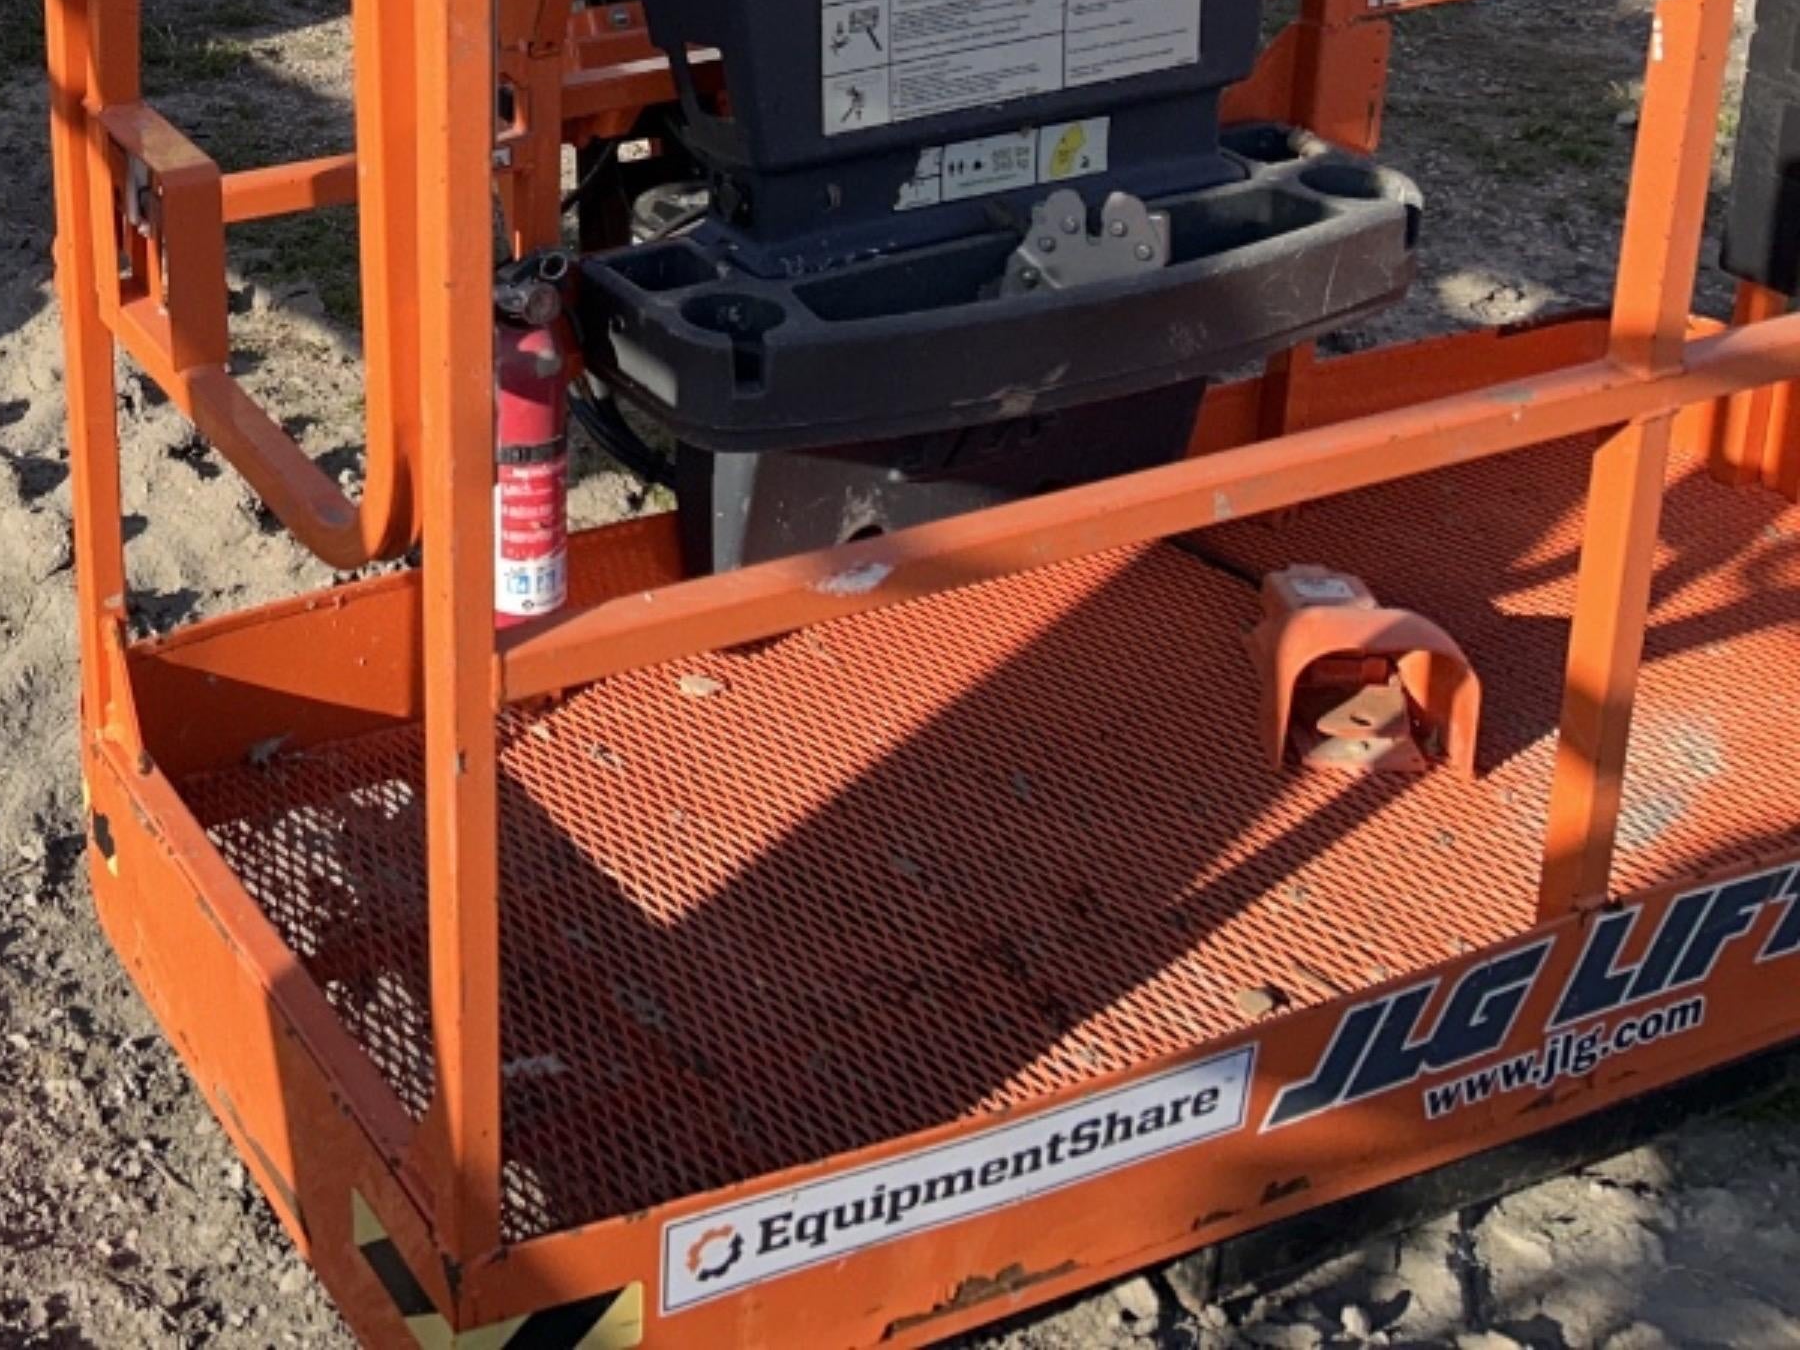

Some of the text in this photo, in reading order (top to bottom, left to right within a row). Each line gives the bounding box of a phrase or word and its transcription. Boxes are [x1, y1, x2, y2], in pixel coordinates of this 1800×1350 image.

[1258, 935, 1557, 1134] JLG
[1423, 993, 1705, 1119] www.jlg.com
[755, 1084, 1220, 1256] EquipmentShare
